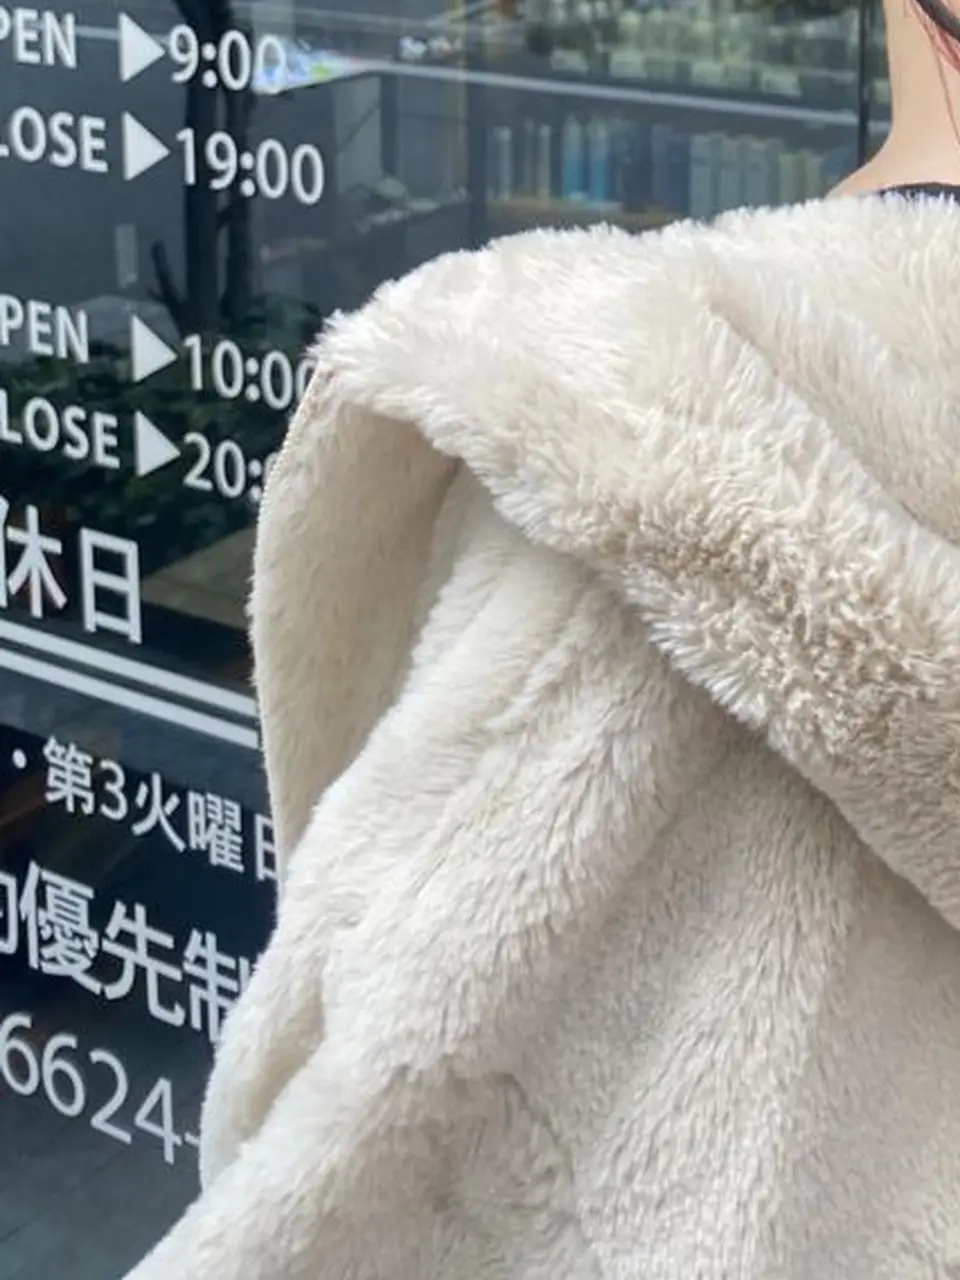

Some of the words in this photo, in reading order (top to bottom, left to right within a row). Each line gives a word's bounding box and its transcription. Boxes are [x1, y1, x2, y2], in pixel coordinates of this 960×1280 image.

[168, 23, 287, 94] 9:00
[175, 127, 325, 205] 19:00
[0, 494, 142, 645] 休日
[0, 860, 250, 1044] 優先制
